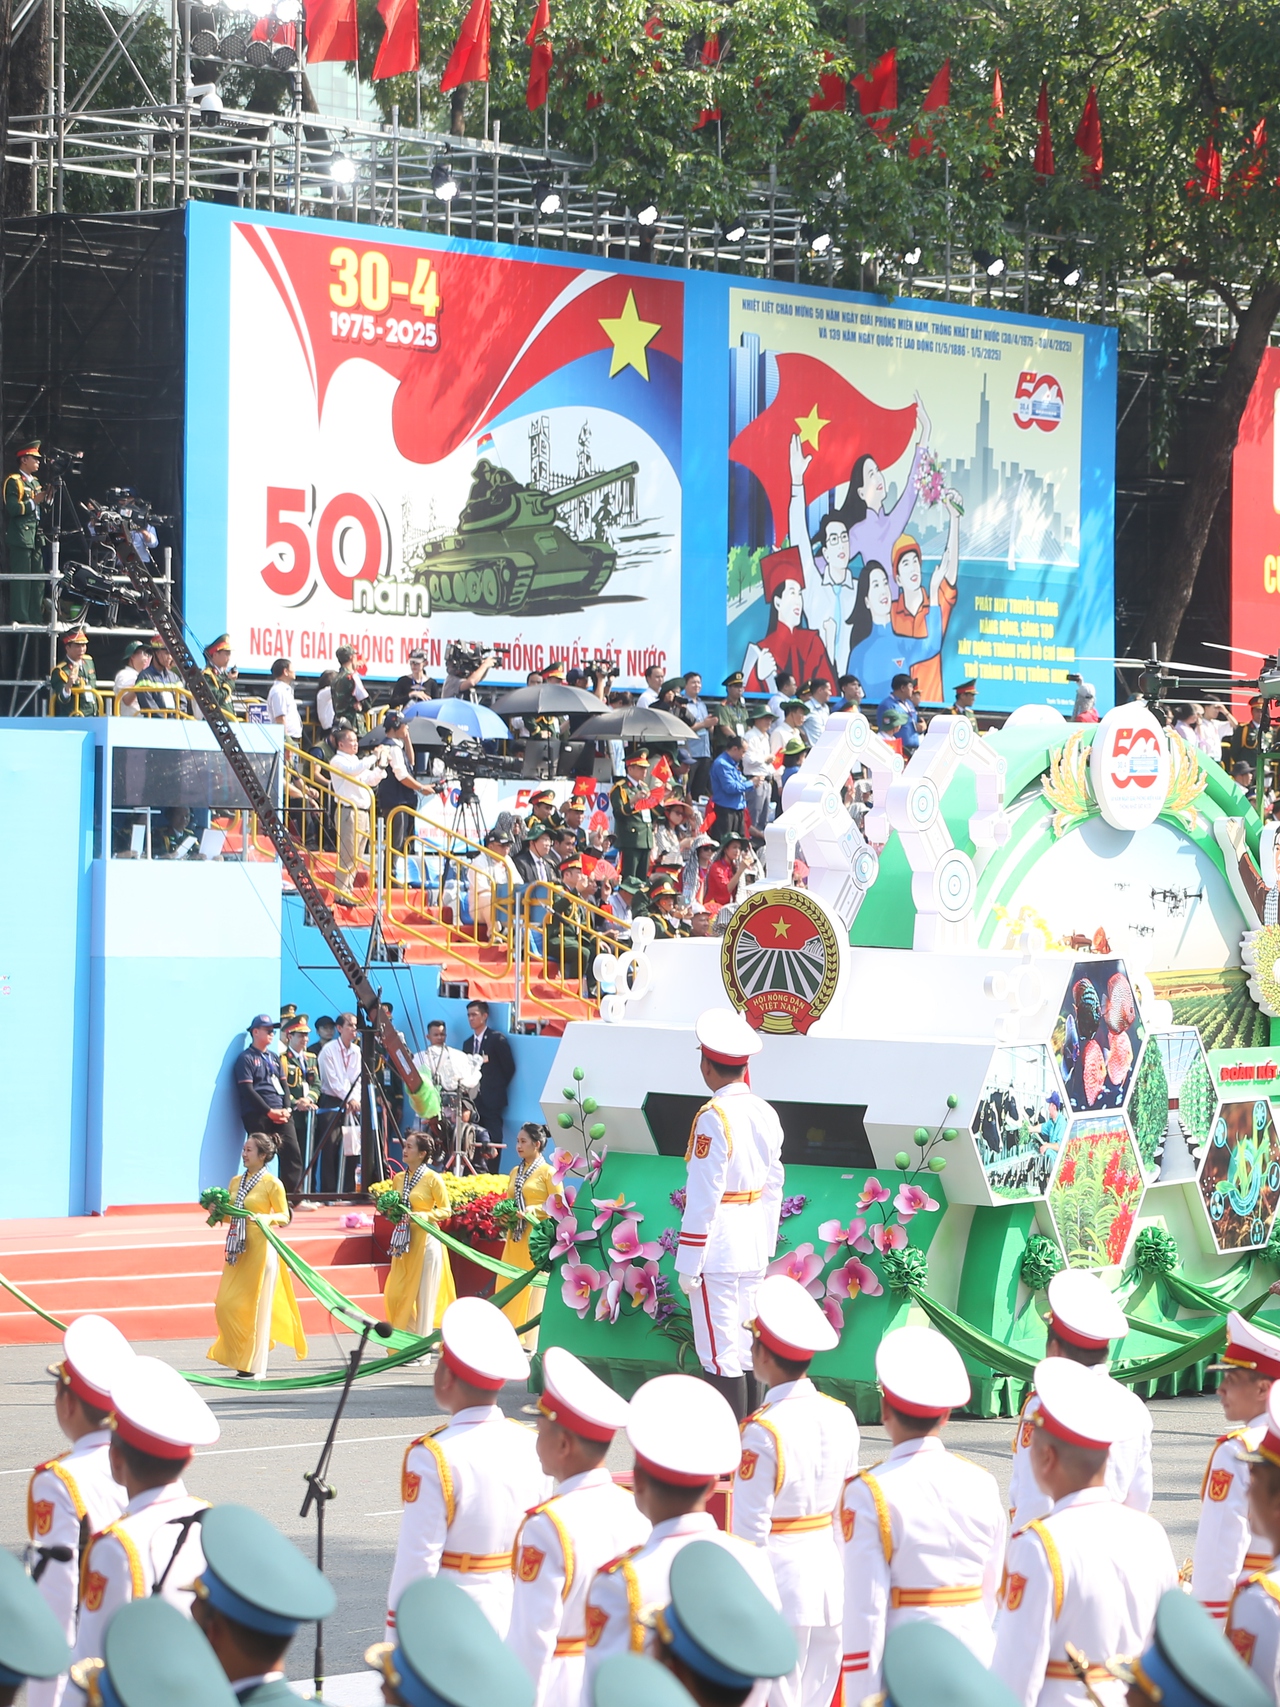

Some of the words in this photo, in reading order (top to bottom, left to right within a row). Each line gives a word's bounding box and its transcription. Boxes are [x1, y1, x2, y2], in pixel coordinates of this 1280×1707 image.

[329, 246, 440, 317] 30-4
[742, 298, 760, 313] NHIỆT
[762, 300, 774, 315] LIỆT
[776, 302, 793, 316] CHÀO
[815, 307, 824, 320] 50
[826, 308, 840, 322] NĂM
[842, 311, 858, 325] NGÀY
[875, 315, 896, 329] PHÓNG
[818, 326, 827, 340] VÀ
[829, 328, 840, 341] 139
[842, 328, 856, 342] NĂM
[858, 331, 875, 345] NGÀY
[876, 332, 893, 347] QUỐC
[904, 337, 915, 350] LAO
[916, 339, 934, 353] ĐỘNG
[260, 485, 383, 601] 50
[352, 571, 432, 618] năm
[250, 622, 294, 658] NGÀY
[300, 622, 333, 660] GIẢI
[753, 995, 767, 1006] HỘI
[767, 993, 788, 1003] NÔNG
[790, 997, 805, 1010] DÂN
[759, 1001, 778, 1011] VIỆT
[780, 1004, 799, 1014] NAM
[1220, 1063, 1255, 1081] ĐOÀN
[1256, 1059, 1278, 1080] KẾT
